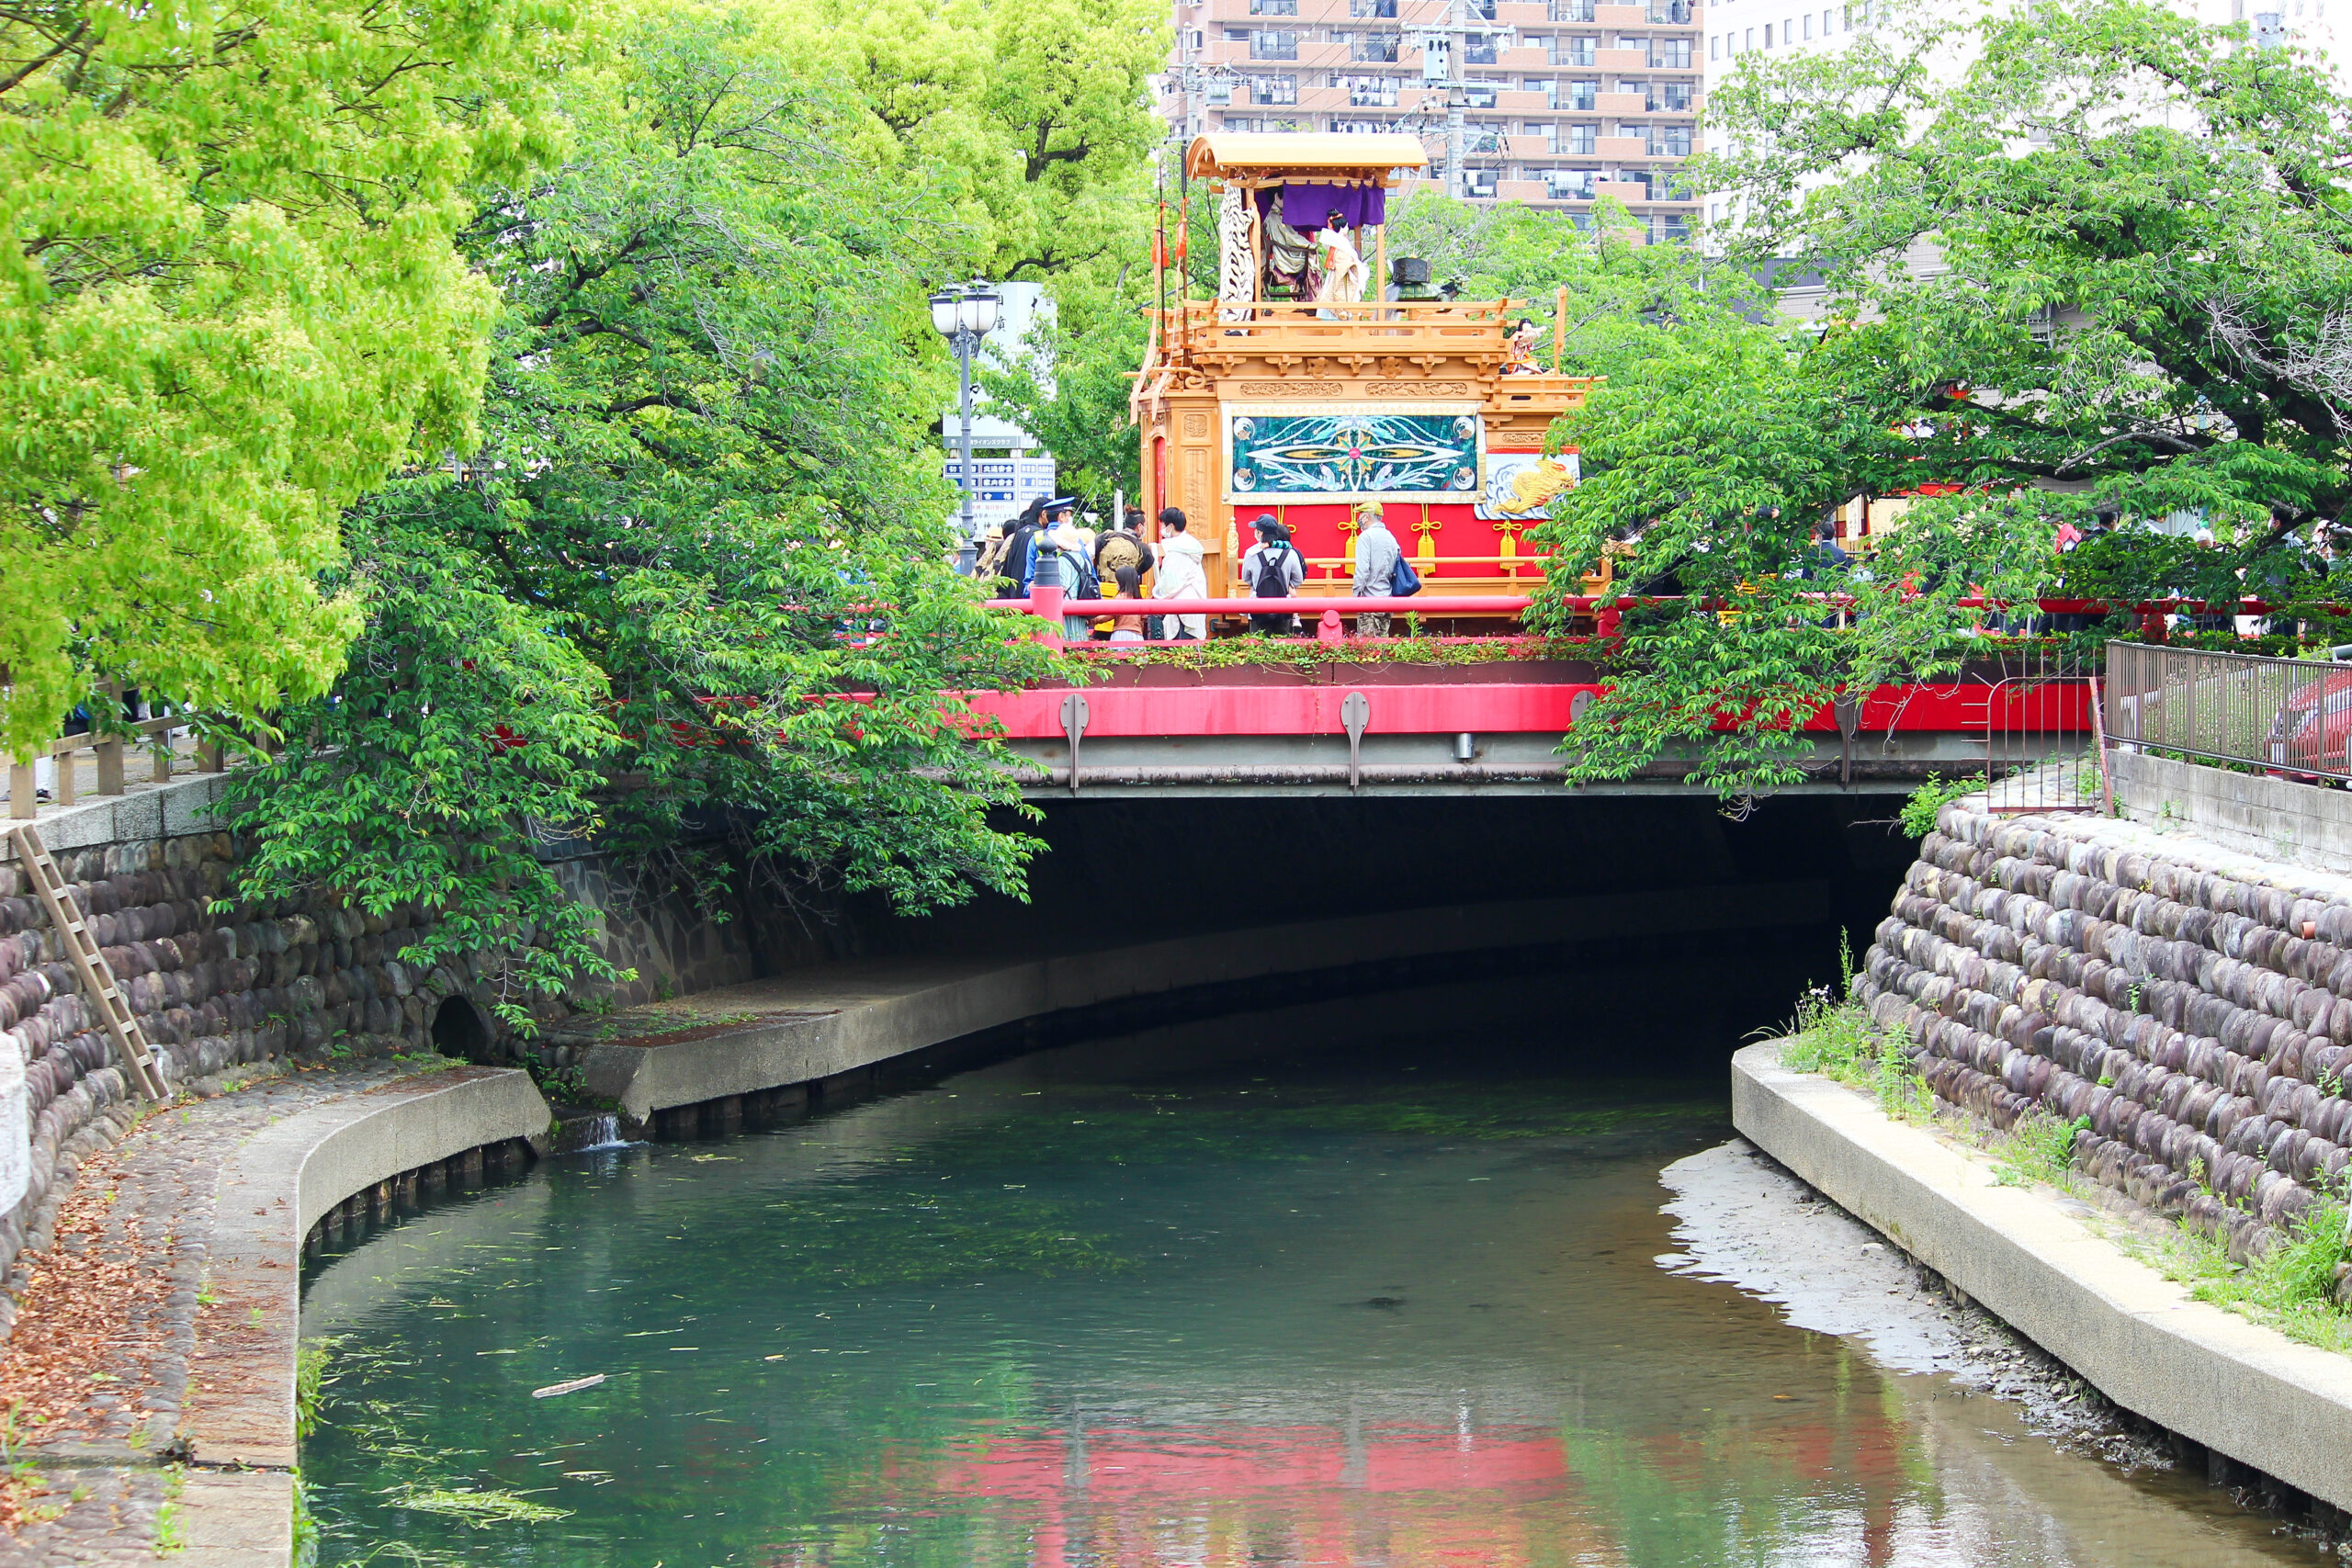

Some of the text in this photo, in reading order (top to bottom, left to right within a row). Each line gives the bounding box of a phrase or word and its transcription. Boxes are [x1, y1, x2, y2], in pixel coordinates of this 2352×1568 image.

[983, 465, 1013, 473] 交通安全
[983, 478, 1013, 487] 家内安全
